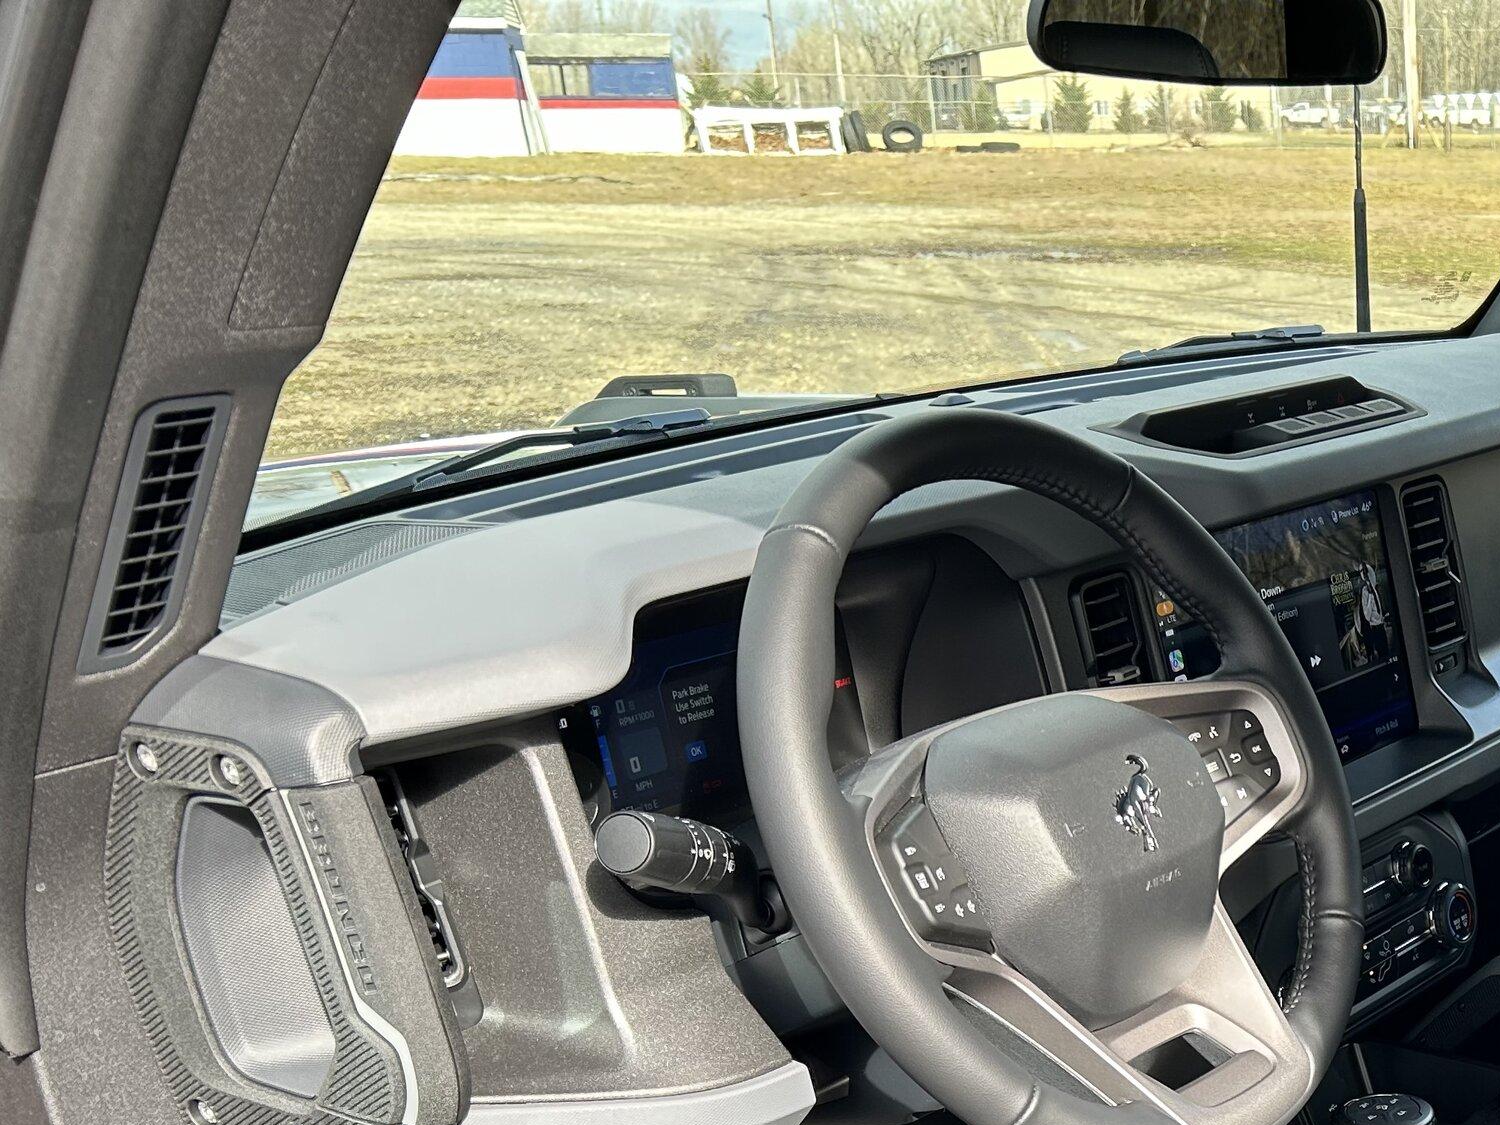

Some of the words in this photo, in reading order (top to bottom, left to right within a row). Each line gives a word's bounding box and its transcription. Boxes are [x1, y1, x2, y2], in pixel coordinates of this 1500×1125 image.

[672, 688, 689, 700] Park
[689, 683, 709, 696] Brake
[675, 702, 689, 713] Use
[689, 694, 714, 709] Switch
[679, 715, 687, 725] to
[687, 708, 715, 723] Release
[690, 746, 703, 757] OK
[630, 756, 641, 773] 0
[635, 779, 653, 791] MPH
[613, 789, 619, 799] E
[299, 801, 378, 996] BRONCO
